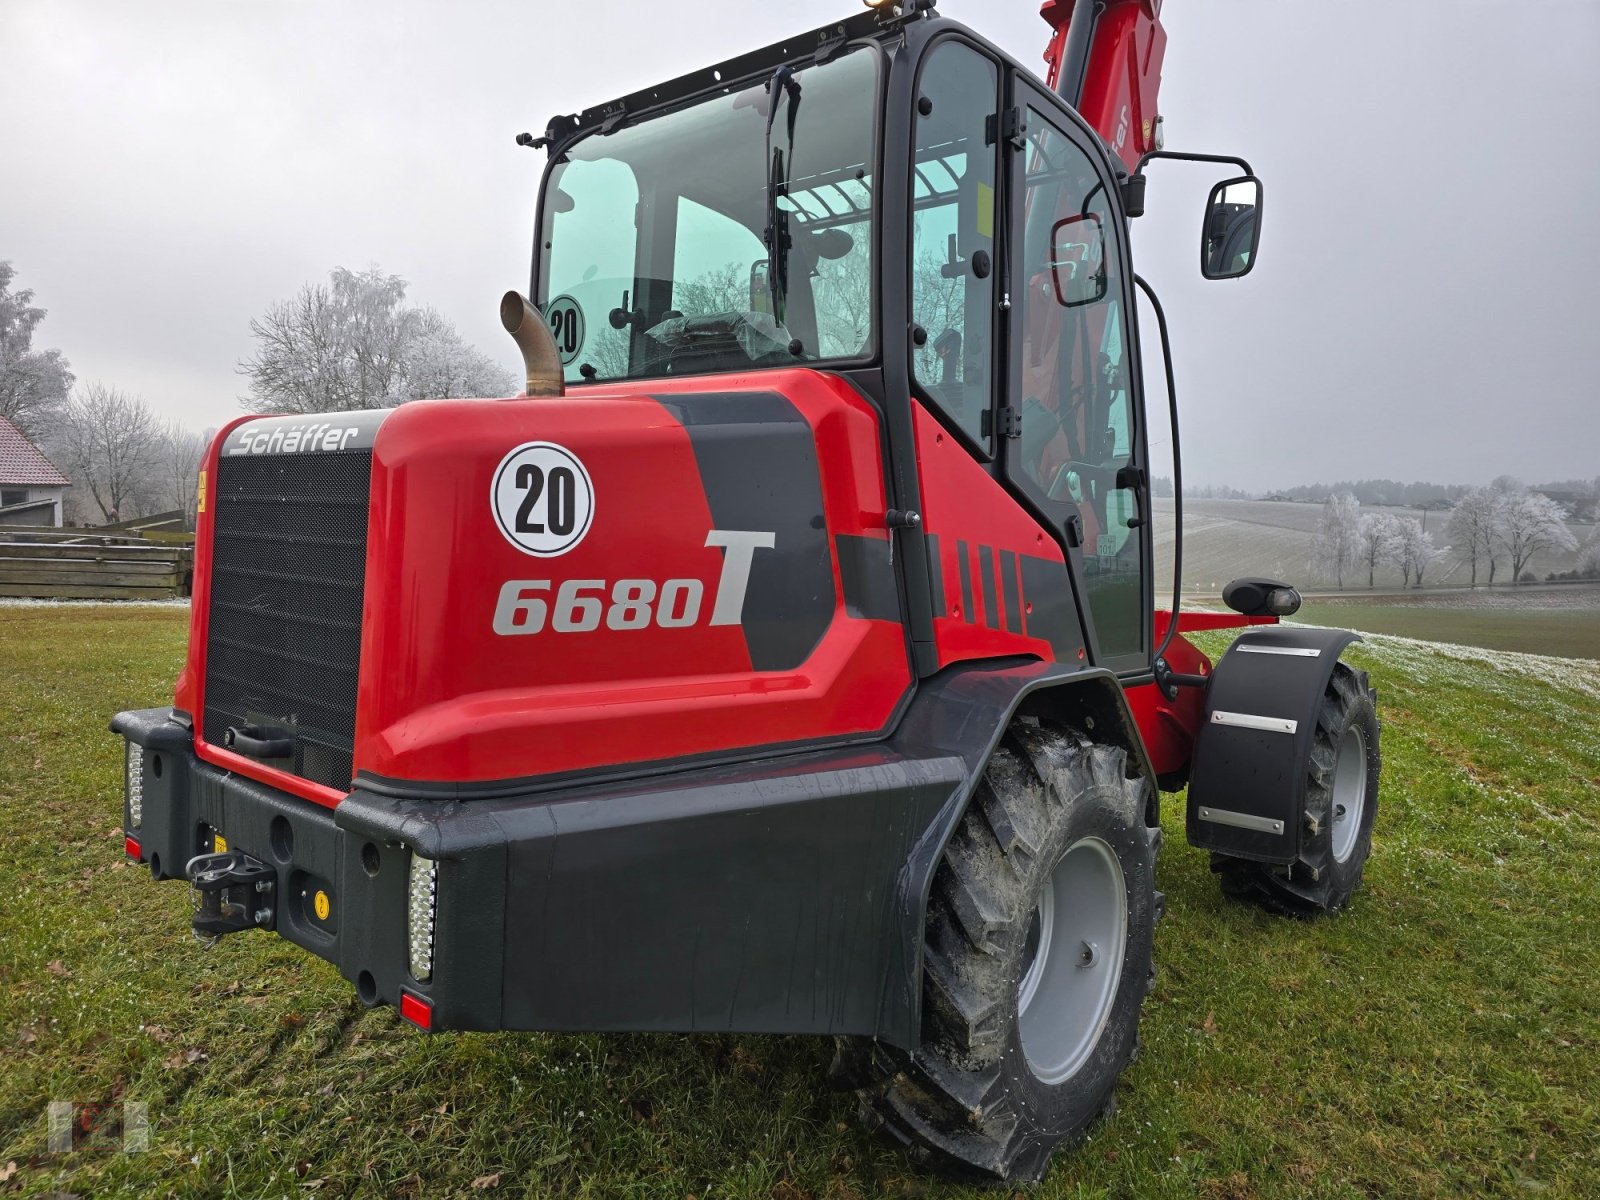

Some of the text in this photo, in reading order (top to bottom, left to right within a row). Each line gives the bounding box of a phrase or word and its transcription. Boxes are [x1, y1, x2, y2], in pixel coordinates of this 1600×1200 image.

[550, 308, 577, 353] 20
[228, 423, 359, 455] Schäffer
[515, 463, 576, 536] 20
